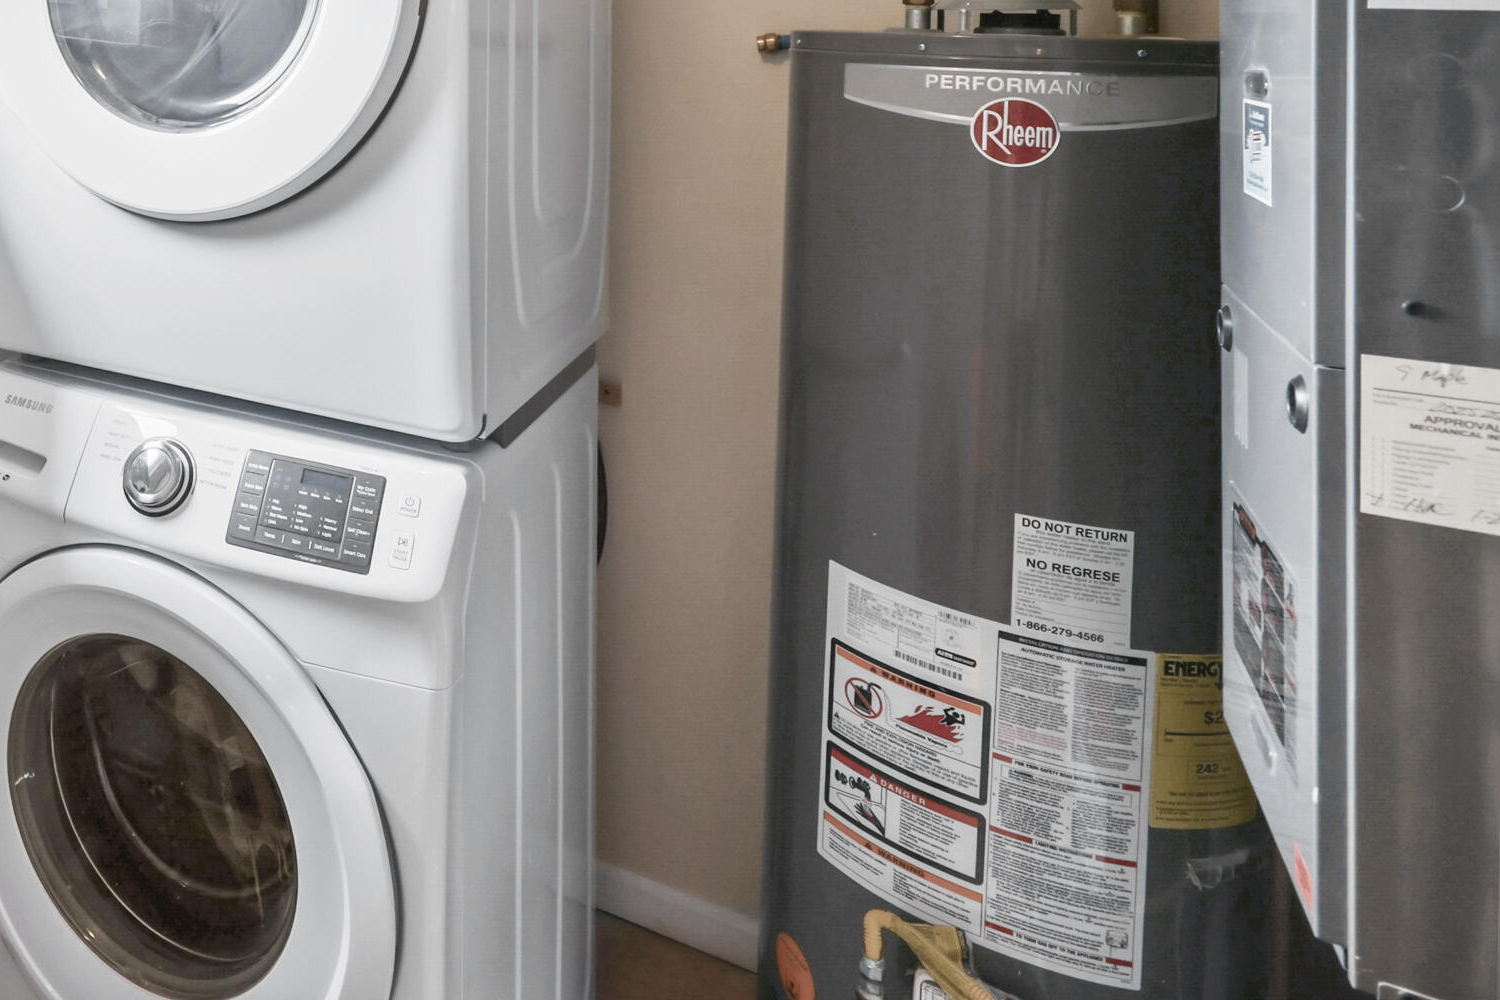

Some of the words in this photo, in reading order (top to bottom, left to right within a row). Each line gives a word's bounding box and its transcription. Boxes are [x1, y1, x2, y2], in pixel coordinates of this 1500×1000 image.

[925, 73, 1121, 98] PERFORMANCE
[982, 99, 1054, 155] Rheem
[4, 394, 53, 414] SAMSUNG
[1409, 423, 1483, 439] MECHANICAL
[1022, 517, 1041, 529] DO
[1045, 522, 1072, 534] NOT
[1075, 527, 1128, 543] RETURN
[1026, 558, 1047, 570] NO
[1052, 563, 1120, 583] REGRESE
[1016, 619, 1104, 643] 1-866-279-4566
[882, 670, 936, 698] WARNING
[1196, 763, 1219, 774] 242
[880, 780, 926, 806] DANGER
[877, 849, 925, 878] WARNING
